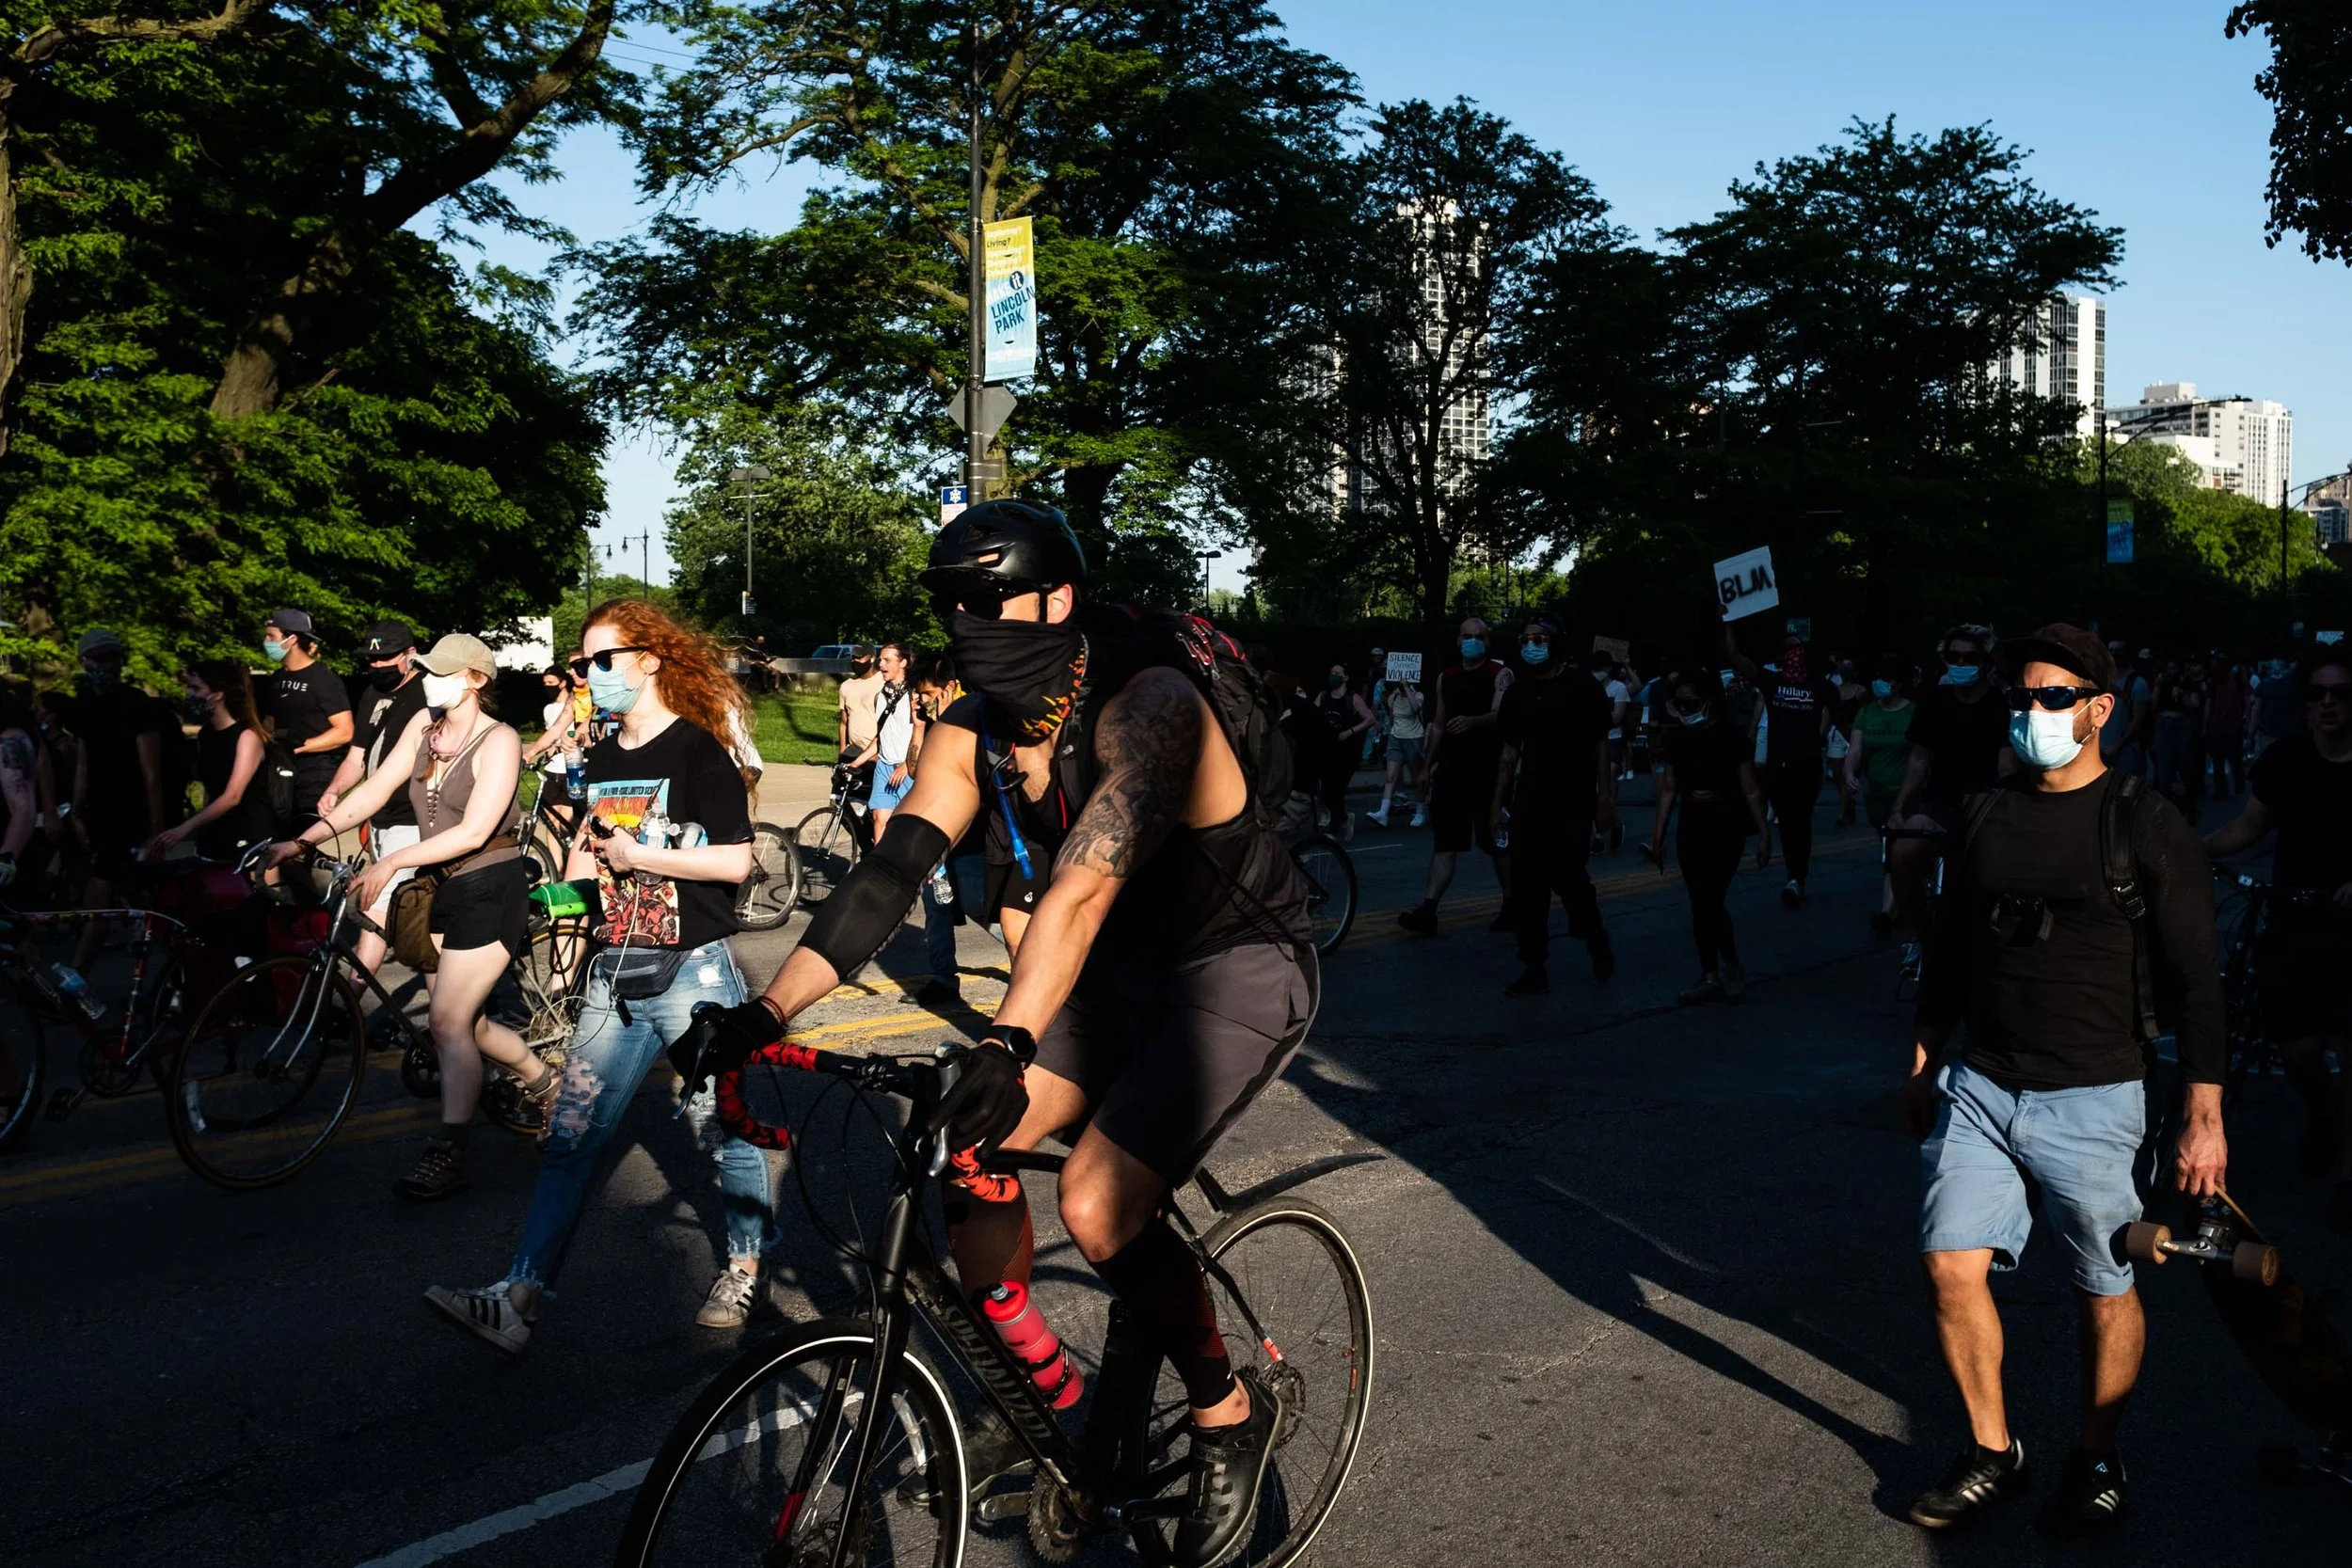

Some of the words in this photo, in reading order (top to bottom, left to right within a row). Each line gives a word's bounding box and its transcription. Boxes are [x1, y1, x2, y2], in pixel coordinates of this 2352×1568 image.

[1010, 272, 1023, 291] it
[991, 285, 1035, 319] LINCOLN
[995, 308, 1025, 335] PARK
[1719, 564, 1772, 604] BLM
[1389, 654, 1421, 663] SILENCE
[1777, 686, 1812, 701] Hillary
